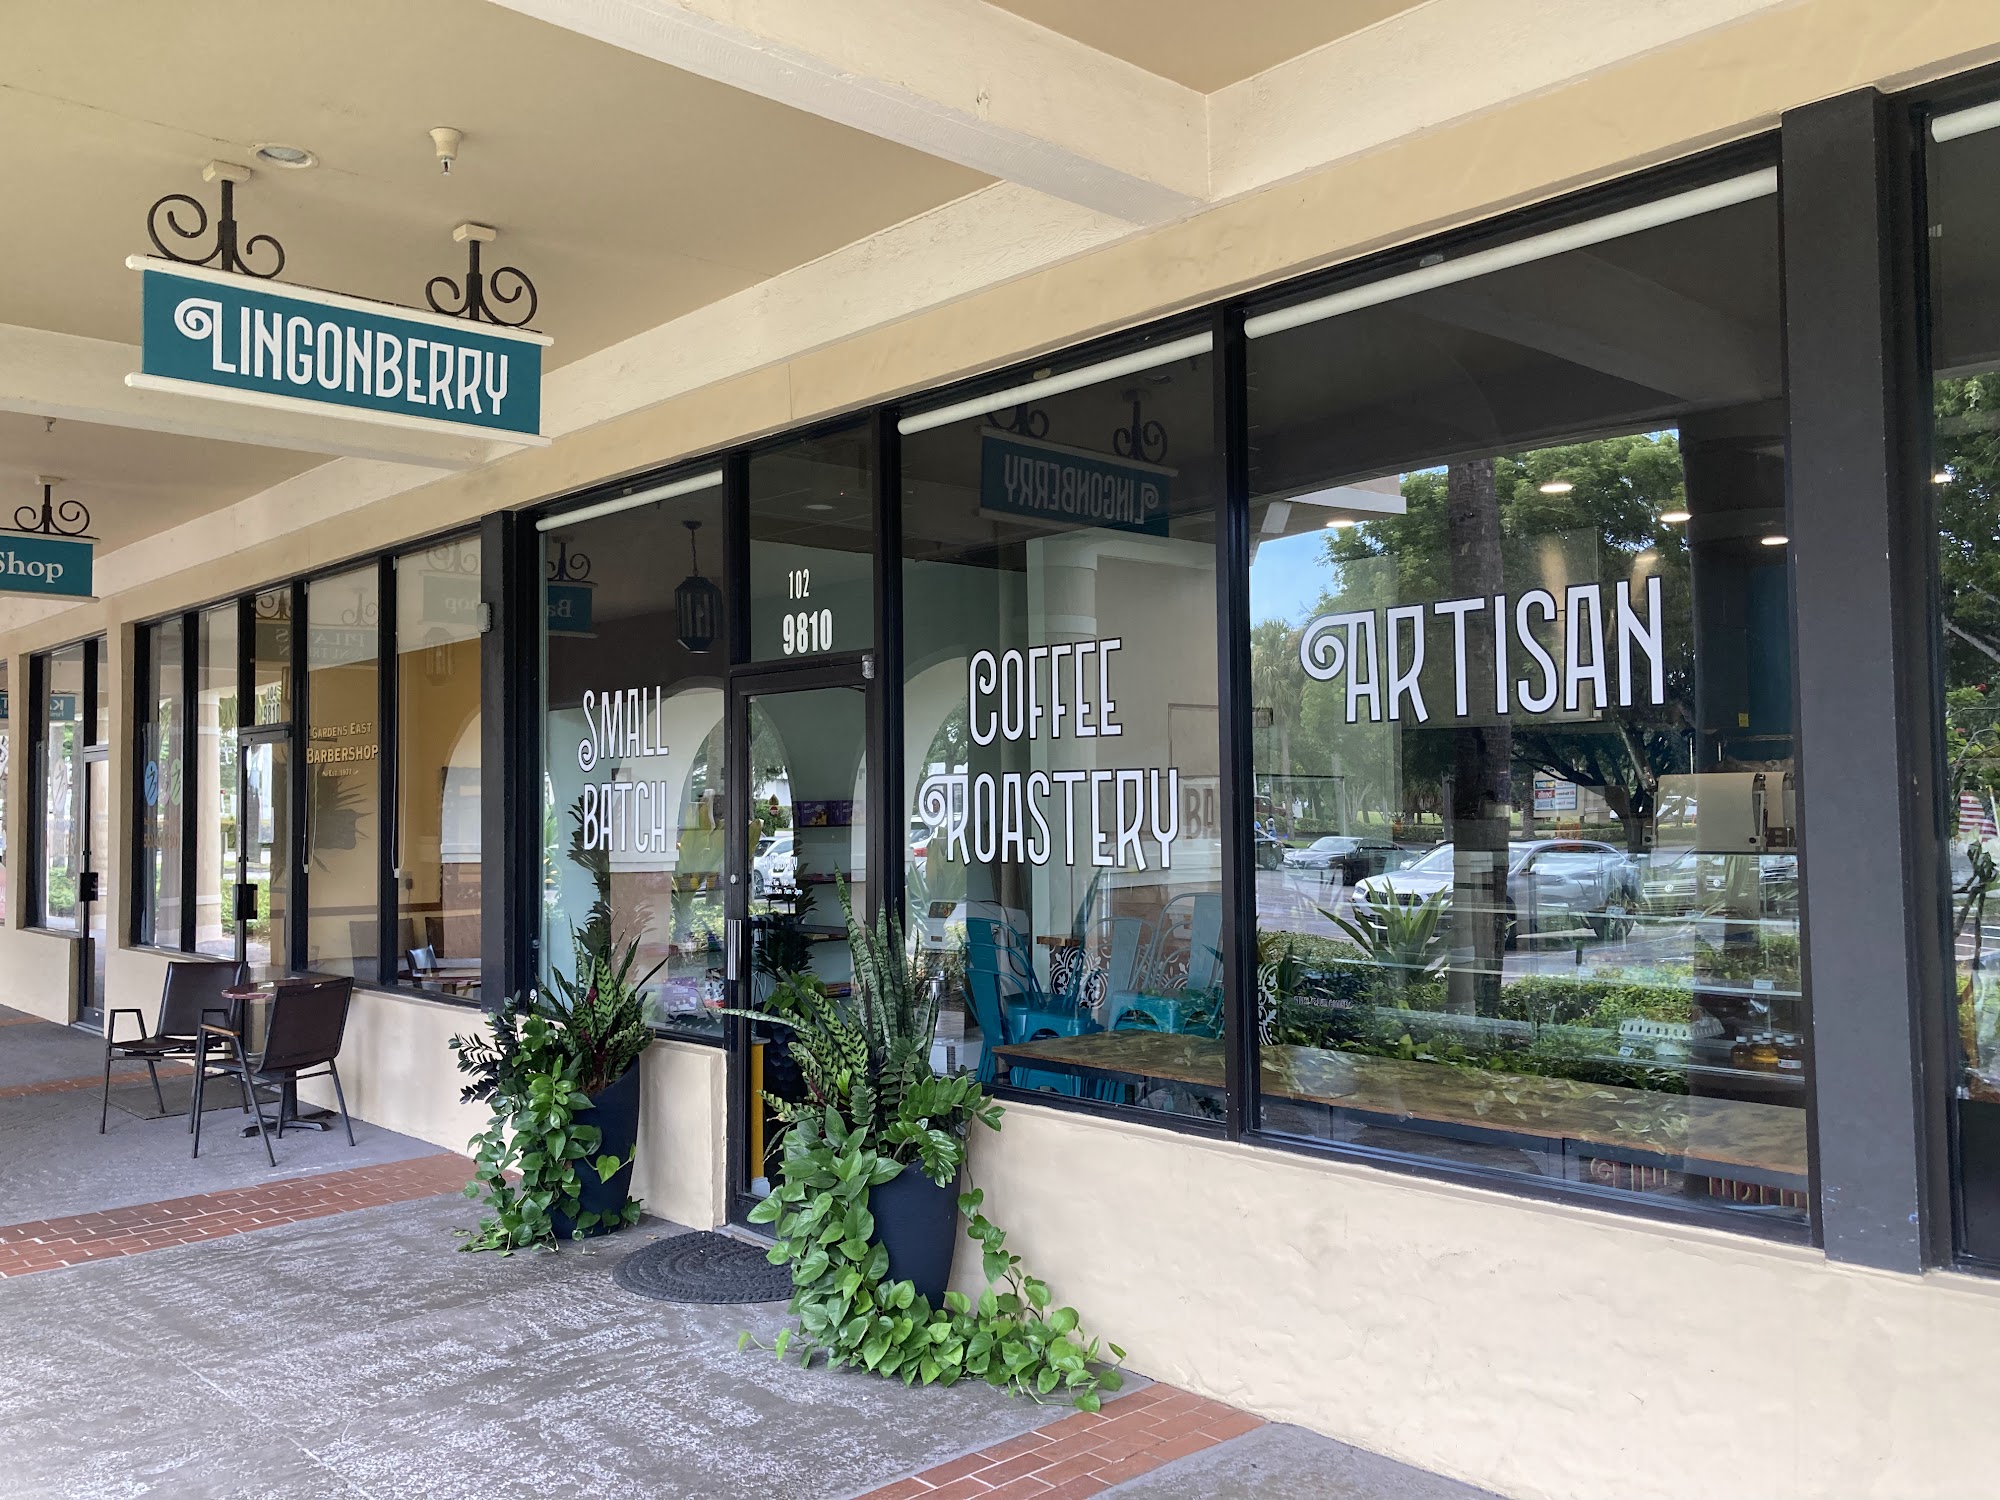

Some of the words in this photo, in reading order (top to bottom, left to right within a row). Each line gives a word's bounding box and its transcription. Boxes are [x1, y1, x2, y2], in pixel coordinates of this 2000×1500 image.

[174, 297, 508, 416] LINGONBERRY
[788, 568, 810, 600] 102
[782, 608, 833, 656] 9810
[1300, 575, 1665, 723] ARTISAN
[312, 726, 348, 739] GARDENS
[350, 722, 372, 735] EAST
[578, 685, 669, 772] SMALL
[969, 637, 1122, 746] COFFEE
[306, 744, 379, 764] BARBERSHOP
[583, 781, 667, 853] BATCH
[918, 767, 1179, 872] ROASTERY
